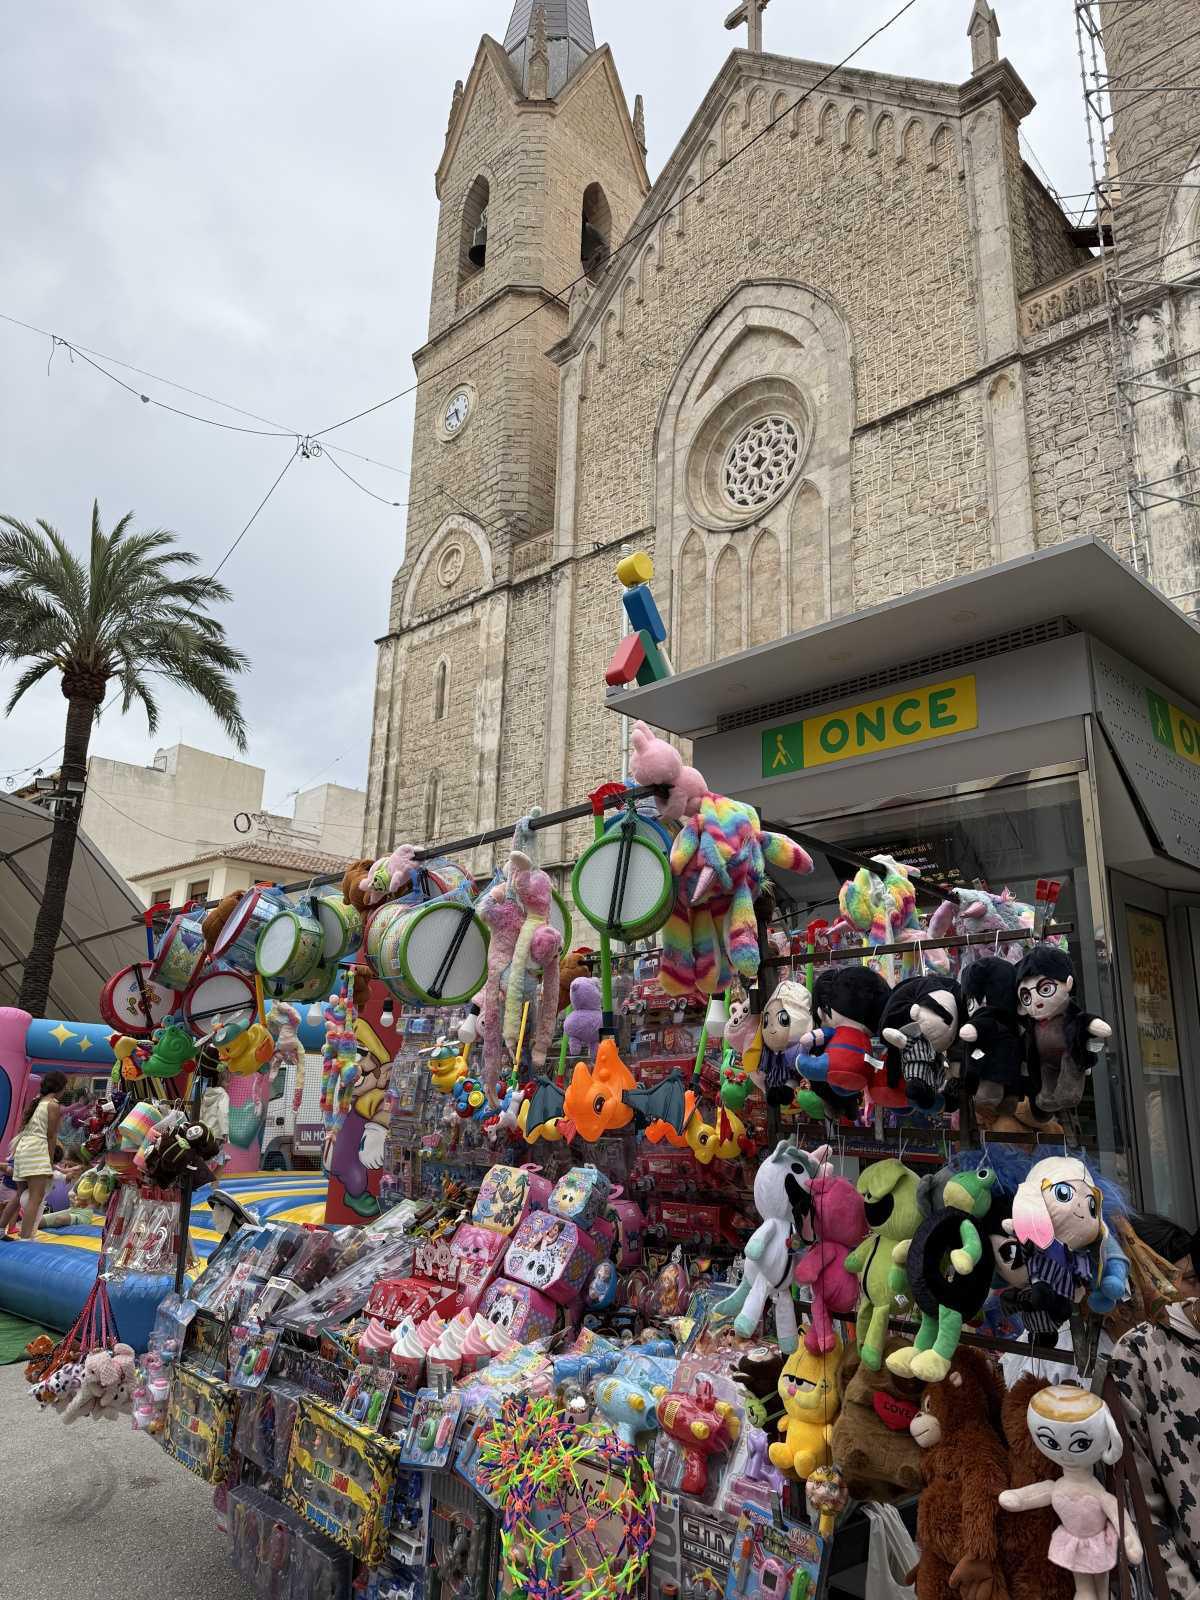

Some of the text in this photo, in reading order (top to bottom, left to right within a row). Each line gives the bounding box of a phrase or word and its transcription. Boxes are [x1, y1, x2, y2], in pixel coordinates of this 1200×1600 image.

[820, 687, 957, 754] ONCE
[300, 1130, 312, 1142] UN
[682, 1516, 736, 1557] CITY
